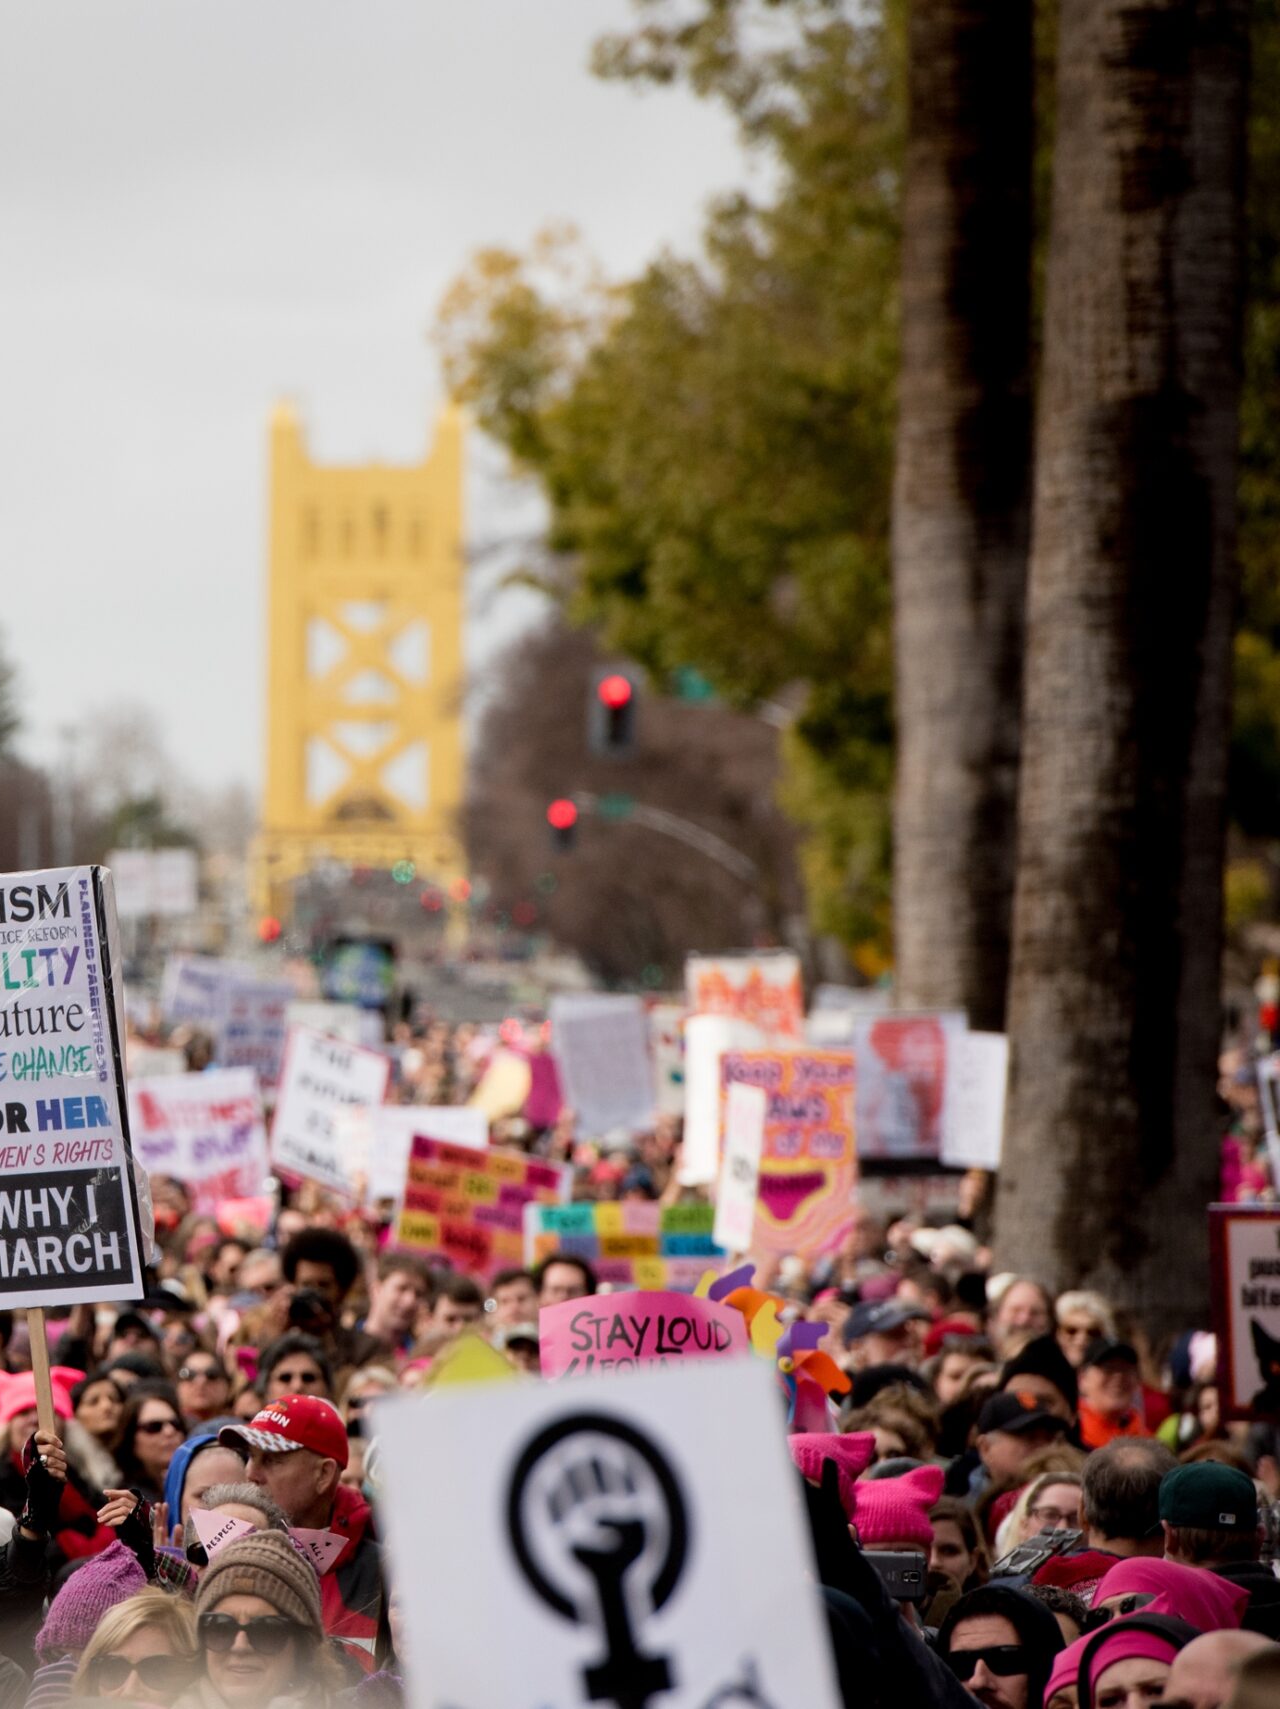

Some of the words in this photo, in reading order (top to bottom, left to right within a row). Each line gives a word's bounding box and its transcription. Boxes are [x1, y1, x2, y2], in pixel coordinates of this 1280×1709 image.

[27, 925, 78, 944] REFORM
[77, 879, 96, 960] PLANNED
[11, 1044, 94, 1082] CHANGE
[36, 1095, 112, 1132] HER
[769, 1094, 822, 1119] AWS
[52, 1138, 114, 1165] RIGHTS
[86, 1184, 99, 1224] I
[570, 1311, 650, 1356] STAY
[655, 1314, 732, 1354] LOUD
[206, 1519, 237, 1551] RESPECT
